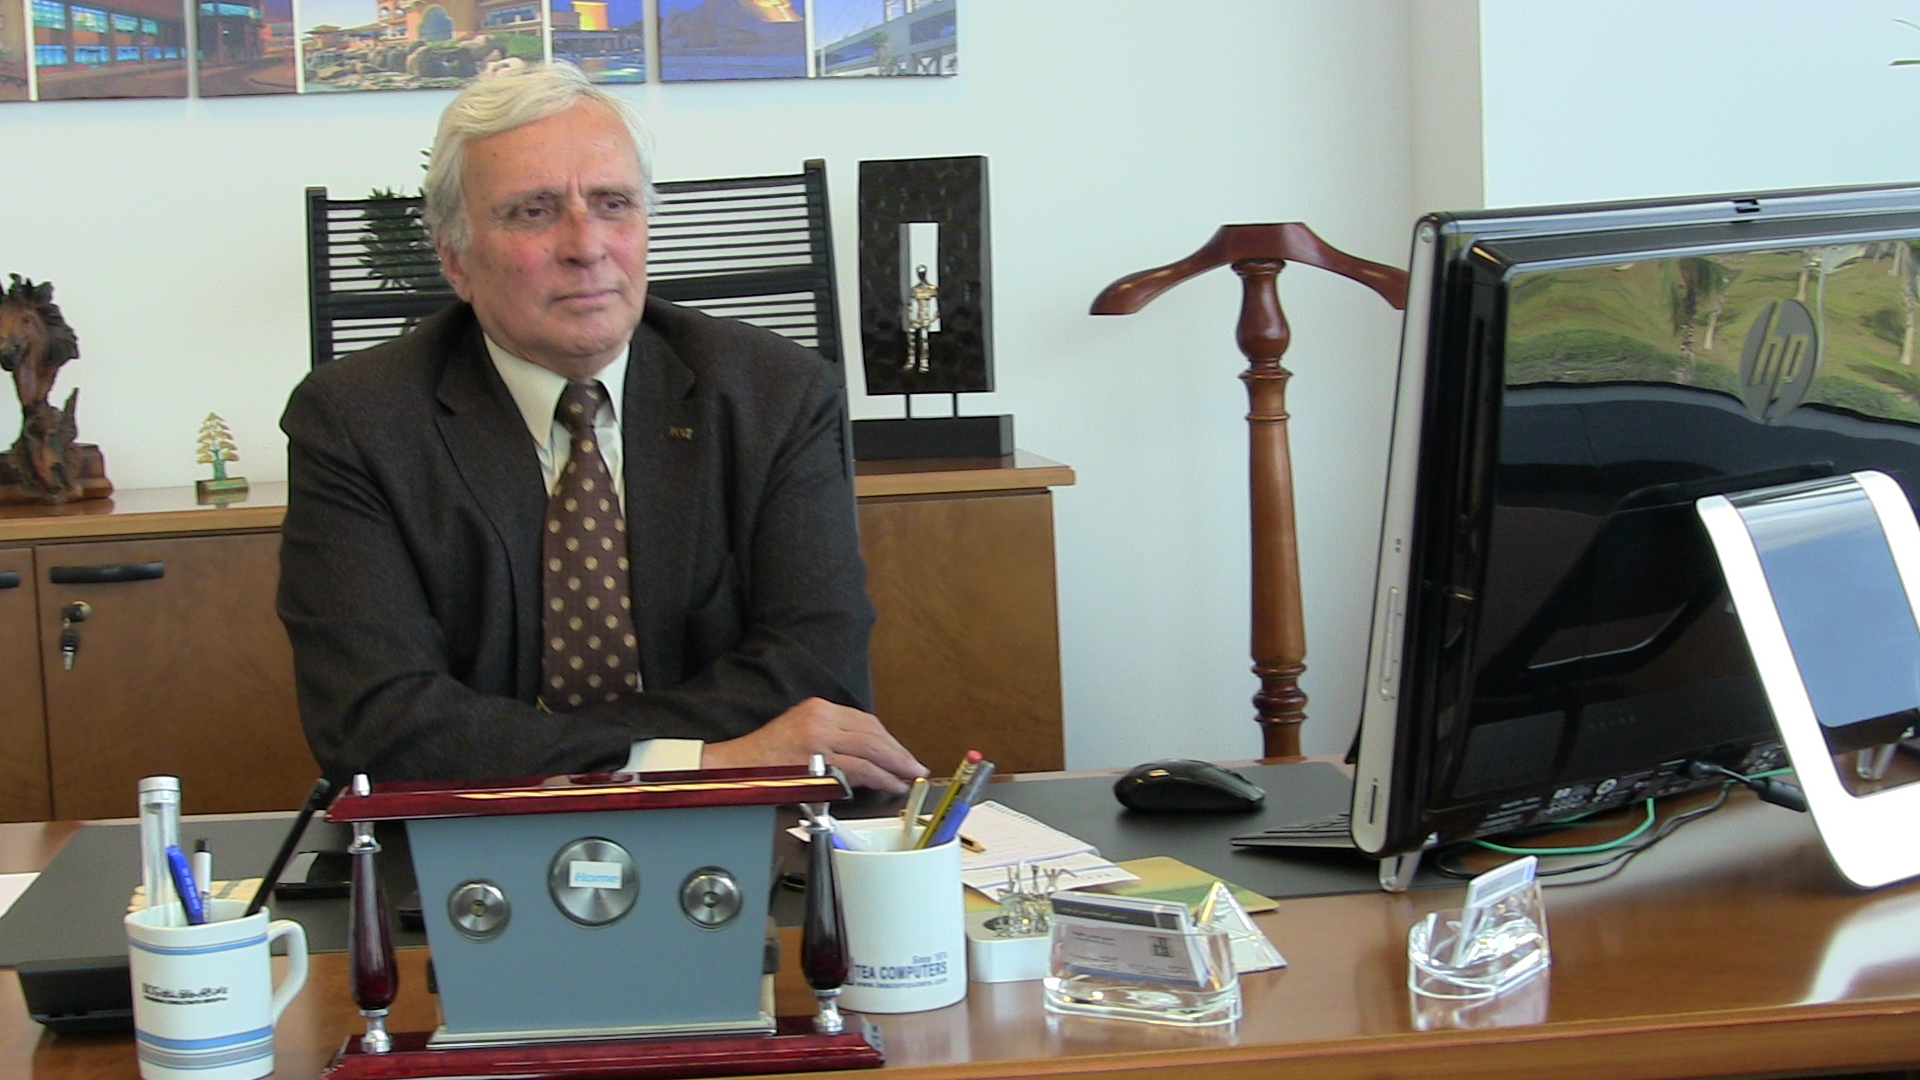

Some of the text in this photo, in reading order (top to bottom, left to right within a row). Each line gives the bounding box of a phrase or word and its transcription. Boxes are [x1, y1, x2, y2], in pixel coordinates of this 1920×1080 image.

[1745, 300, 1811, 420] hp
[855, 961, 947, 980] TEA COMPUTERS
